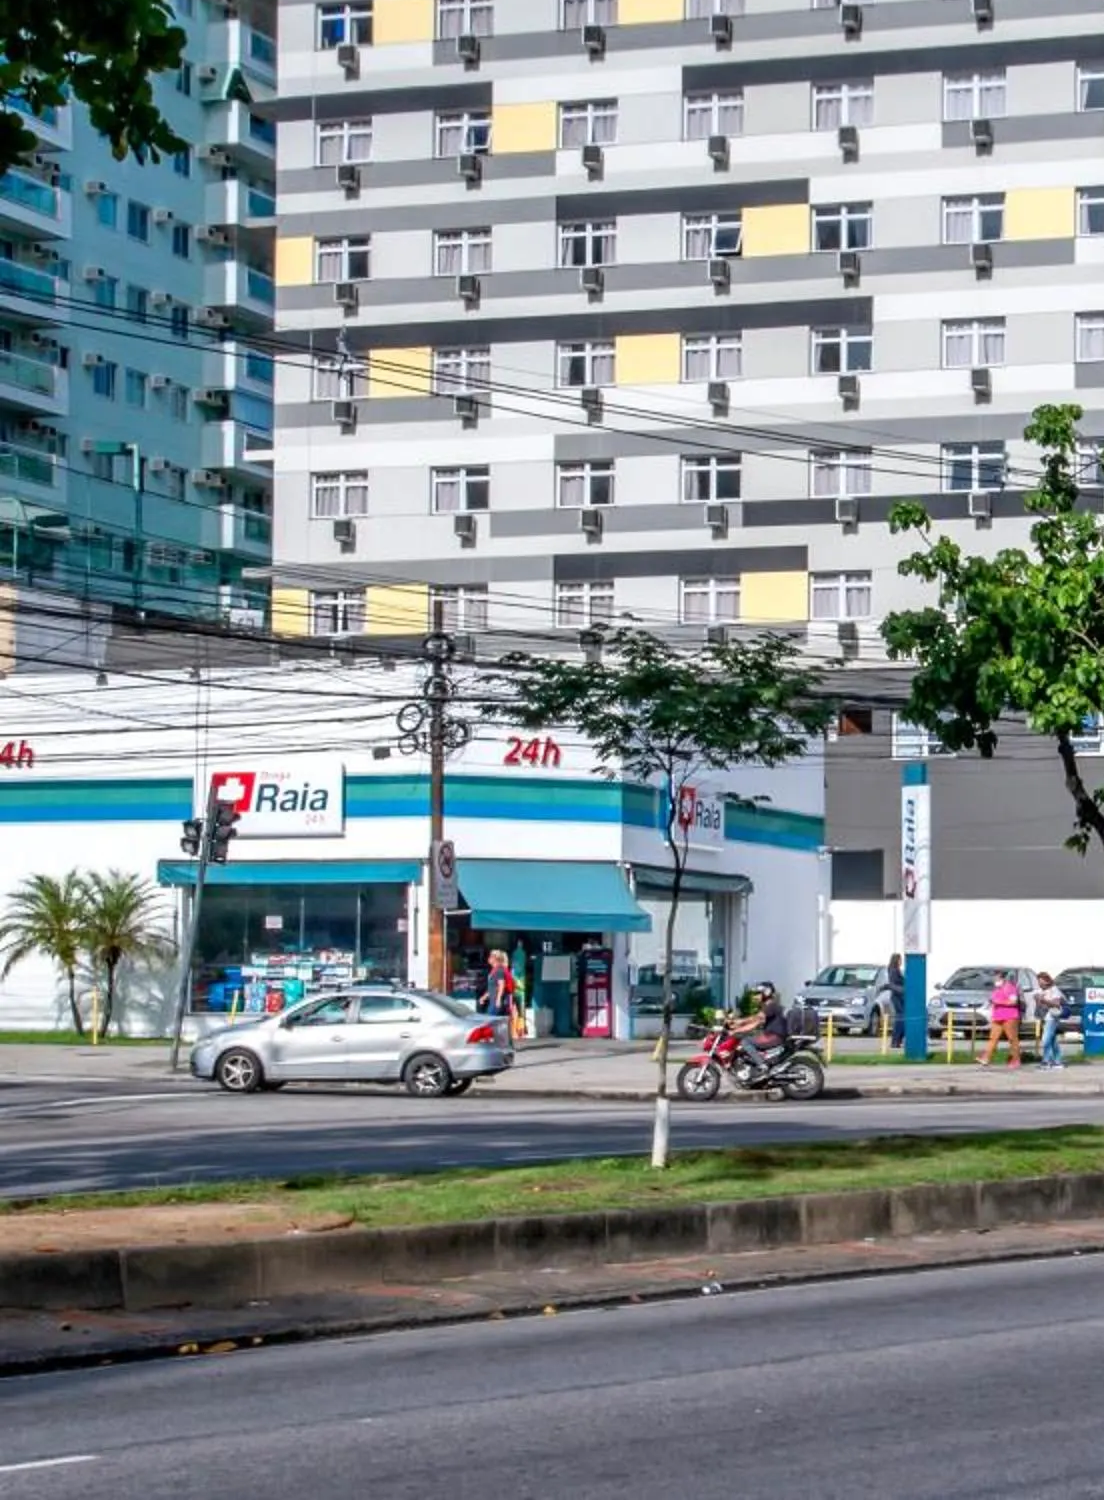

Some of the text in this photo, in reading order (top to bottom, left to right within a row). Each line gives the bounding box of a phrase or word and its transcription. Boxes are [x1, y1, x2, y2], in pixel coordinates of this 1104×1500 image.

[504, 736, 561, 767] 24h
[256, 782, 329, 812] Raia
[696, 800, 721, 830] Raia
